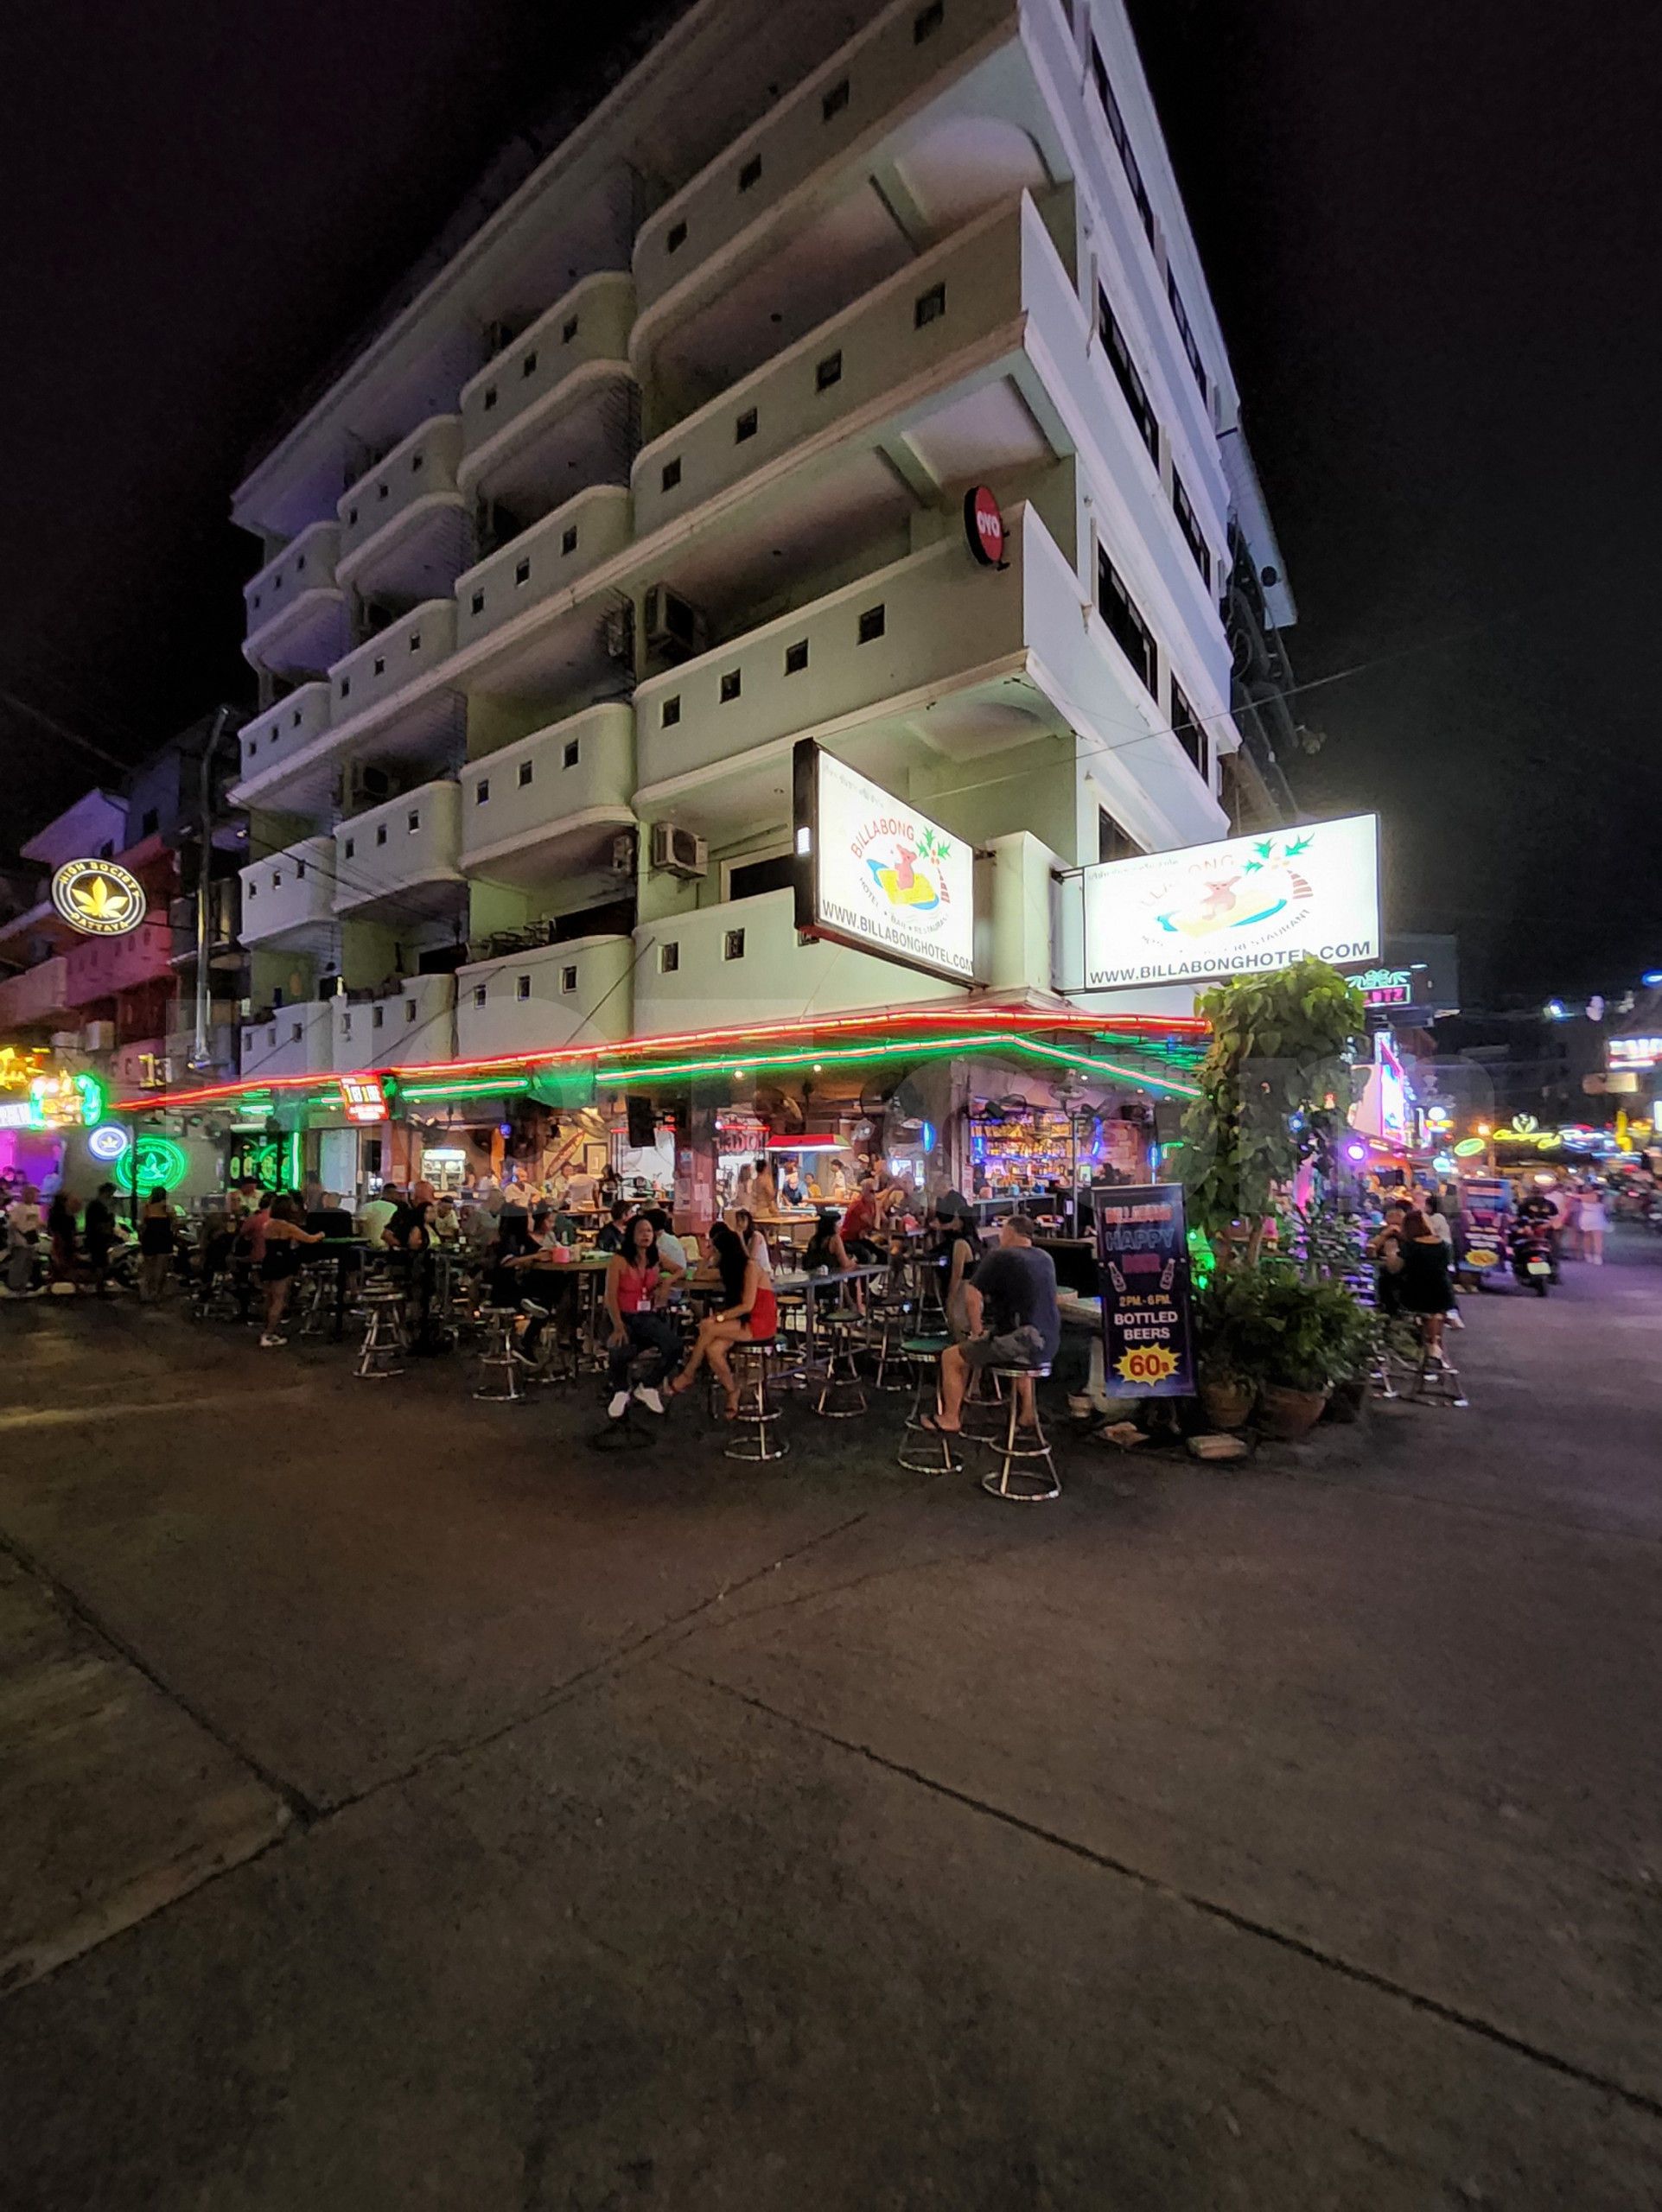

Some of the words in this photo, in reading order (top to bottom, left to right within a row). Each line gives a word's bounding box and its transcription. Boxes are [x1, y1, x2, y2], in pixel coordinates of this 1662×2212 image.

[977, 510, 1000, 538] OYO
[850, 818, 914, 860] BILLABONG
[58, 862, 86, 886] HIGH
[89, 861, 141, 898] SOCIETY
[70, 912, 129, 931] PATTAYA
[914, 913, 949, 935] RETAURAN
[1090, 941, 1371, 985] WWW.BILLABONGHOTELCOM
[1105, 1227, 1176, 1252] HAPPY
[1113, 1311, 1178, 1326] BOTTLED
[1123, 1326, 1170, 1341] BEERS
